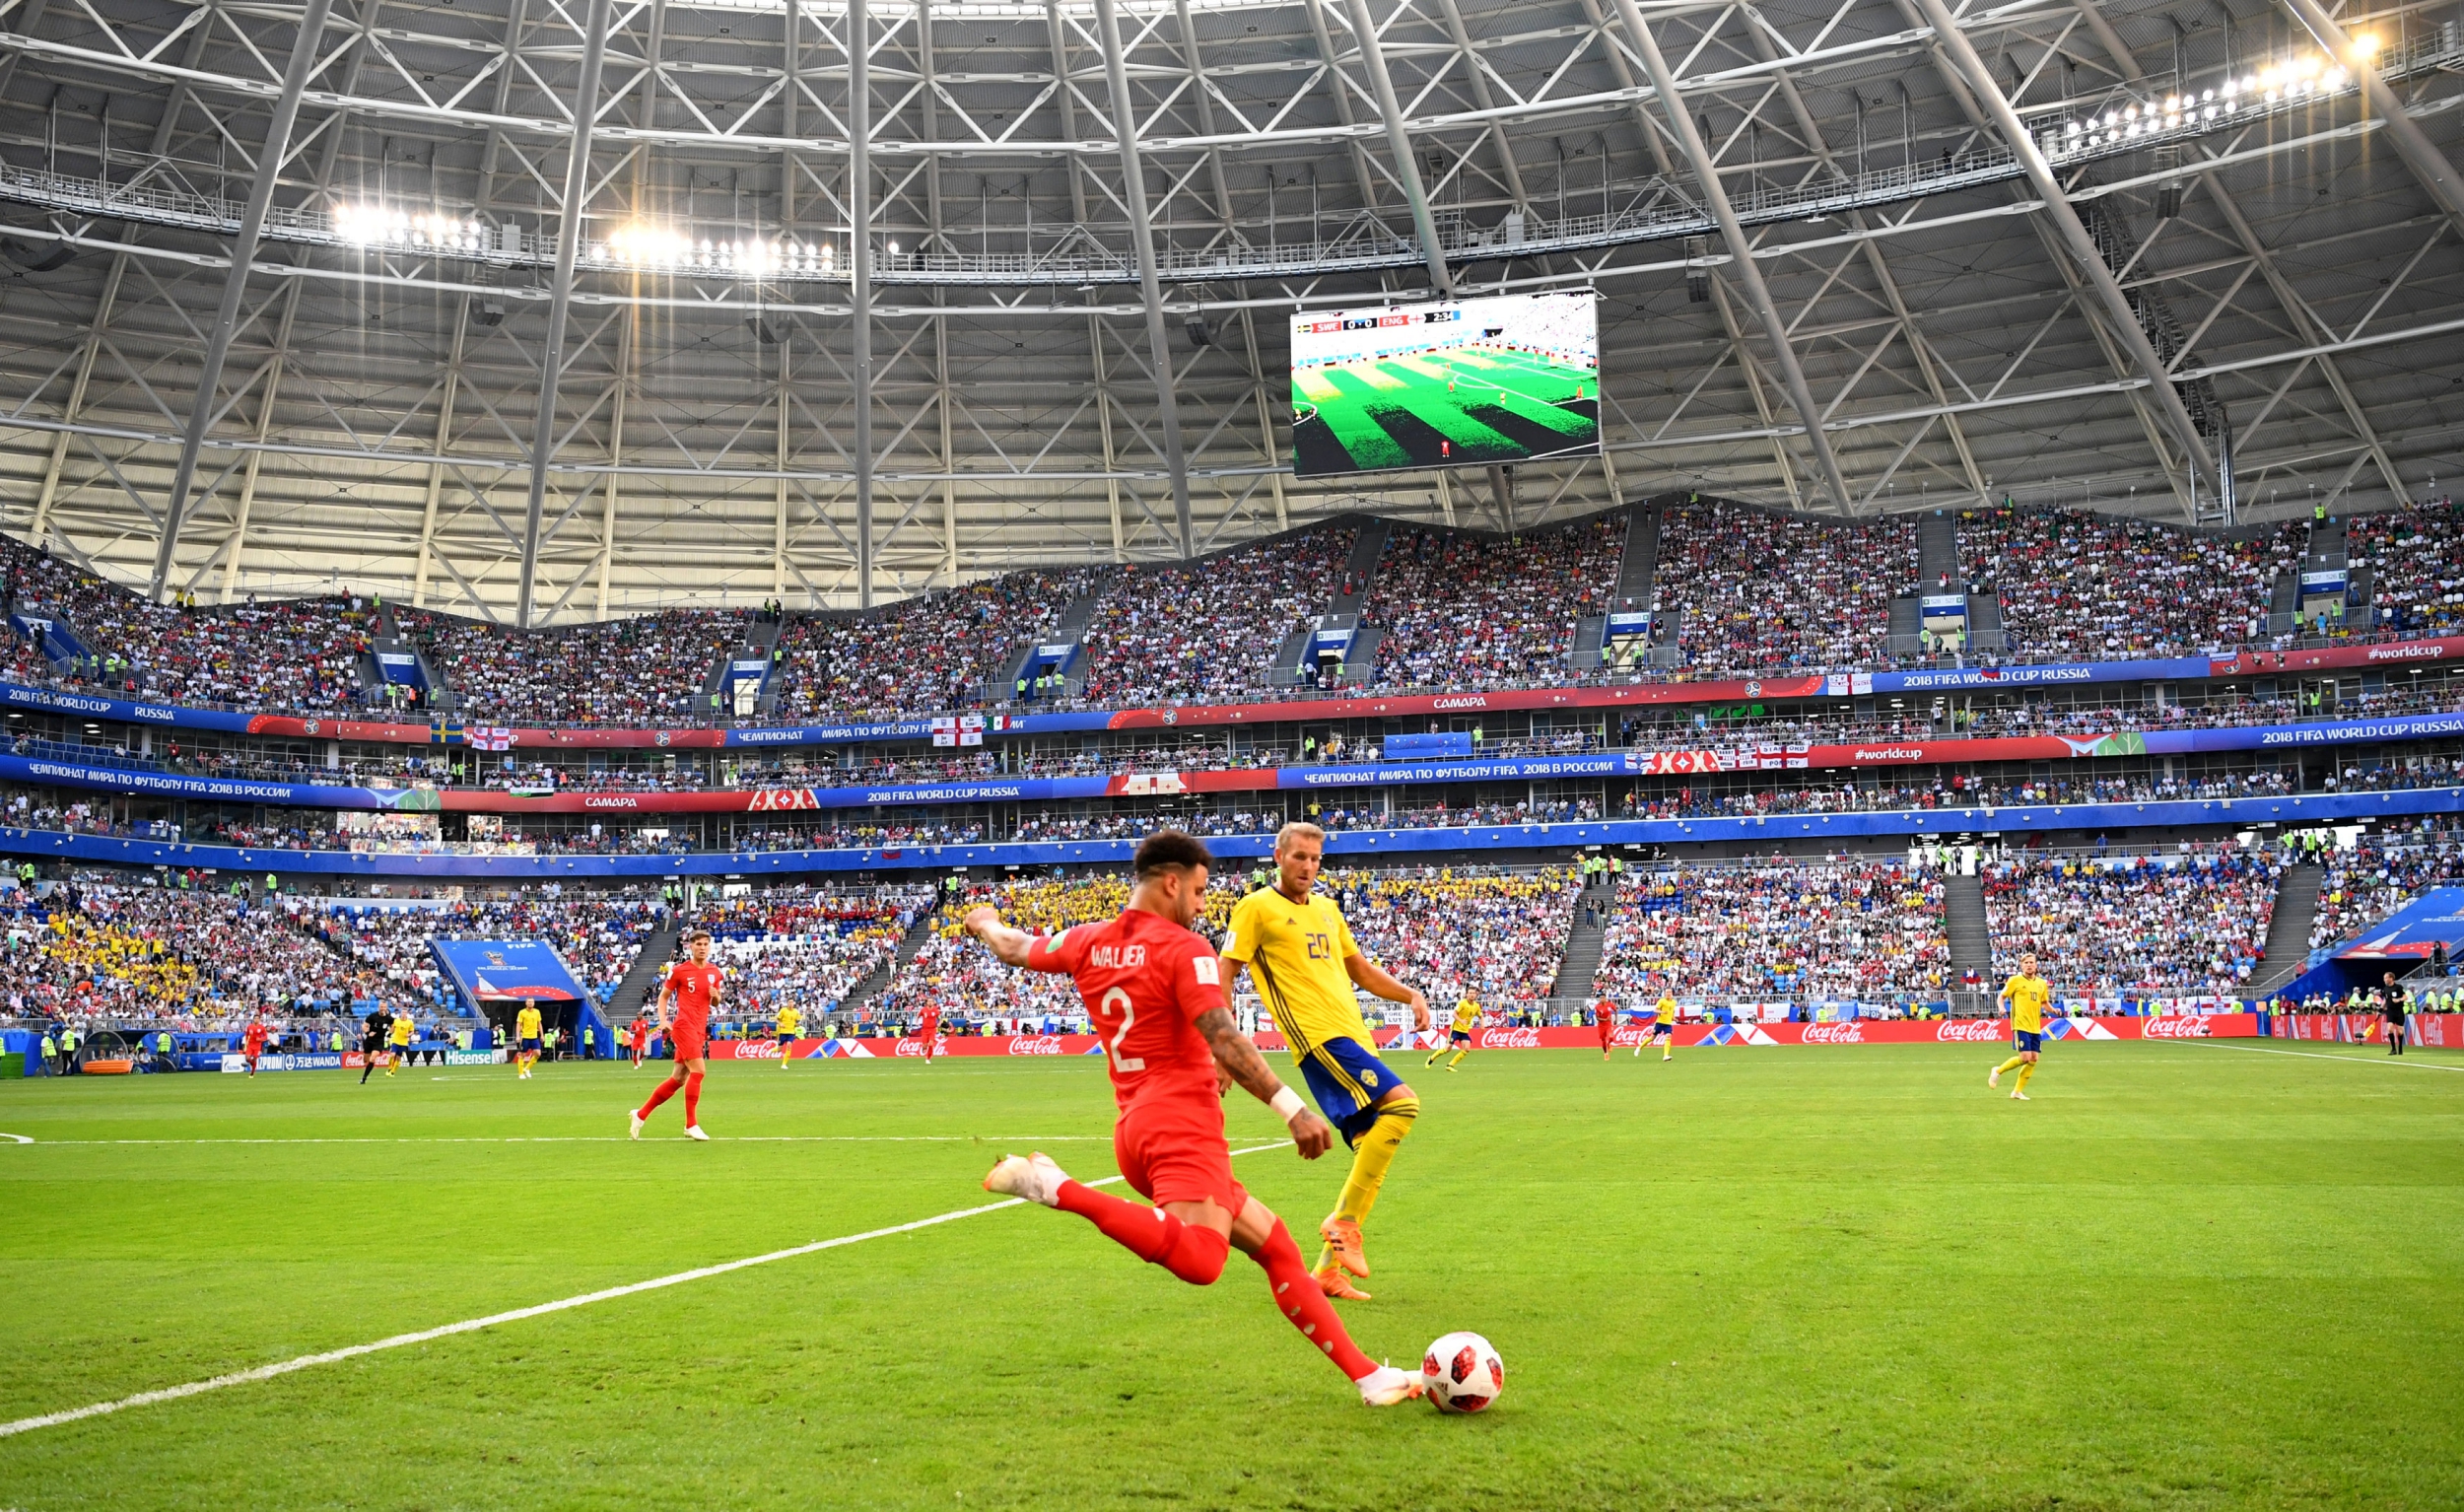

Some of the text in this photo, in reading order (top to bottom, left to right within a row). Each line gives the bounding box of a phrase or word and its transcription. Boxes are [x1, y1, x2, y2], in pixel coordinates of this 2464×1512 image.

[1318, 323, 1338, 332] SWE
[1383, 317, 1403, 326] ENG
[1433, 312, 1455, 322] 2:34
[2368, 645, 2443, 660] #worldcup
[1903, 675, 1932, 687] 2018
[1935, 674, 1961, 685] FIFA
[2012, 671, 2039, 683] CUP
[2041, 668, 2090, 681] RUSSIA
[9, 689, 31, 702] 2018
[89, 700, 111, 713] CUP
[135, 706, 174, 721] RUSSIA
[1433, 696, 1486, 709] САМАРА
[739, 730, 803, 741] ЧЕМПИОНАТ
[822, 728, 853, 738] МИРА
[855, 726, 869, 736] ПО
[2262, 720, 2464, 743] 2018 FIFA WORLD CUP RUSSIA
[1855, 746, 1922, 761] #worldcup
[29, 763, 291, 797] ЧЕМПИОНАТ МИРА ПО ФУТБОЛУ FIFA 2018 В РОССИИ
[1305, 761, 1613, 784] ЧЕМПИОНАТ МИРА ПО ФУТБОЛУ FIFA 2018 В РОССИИ
[584, 796, 637, 808] САМАРА
[867, 786, 1019, 802] 2018 FIFA WORLD CUP RUSSIA
[1305, 932, 1331, 959] 20
[1090, 944, 1145, 969] WALER
[688, 981, 696, 994] 5
[2030, 991, 2037, 1001] 10
[1101, 986, 1145, 1073] 2
[1480, 1028, 1540, 1048] Coca-Cola
[1802, 1022, 1864, 1044] Coca-Cola
[1937, 1019, 2000, 1042] Coca-Cola
[1008, 1035, 1062, 1056] Coca-Cola
[256, 1055, 283, 1070] ZPROM
[312, 1055, 341, 1067] WANDA
[445, 1050, 491, 1065] Hisense
